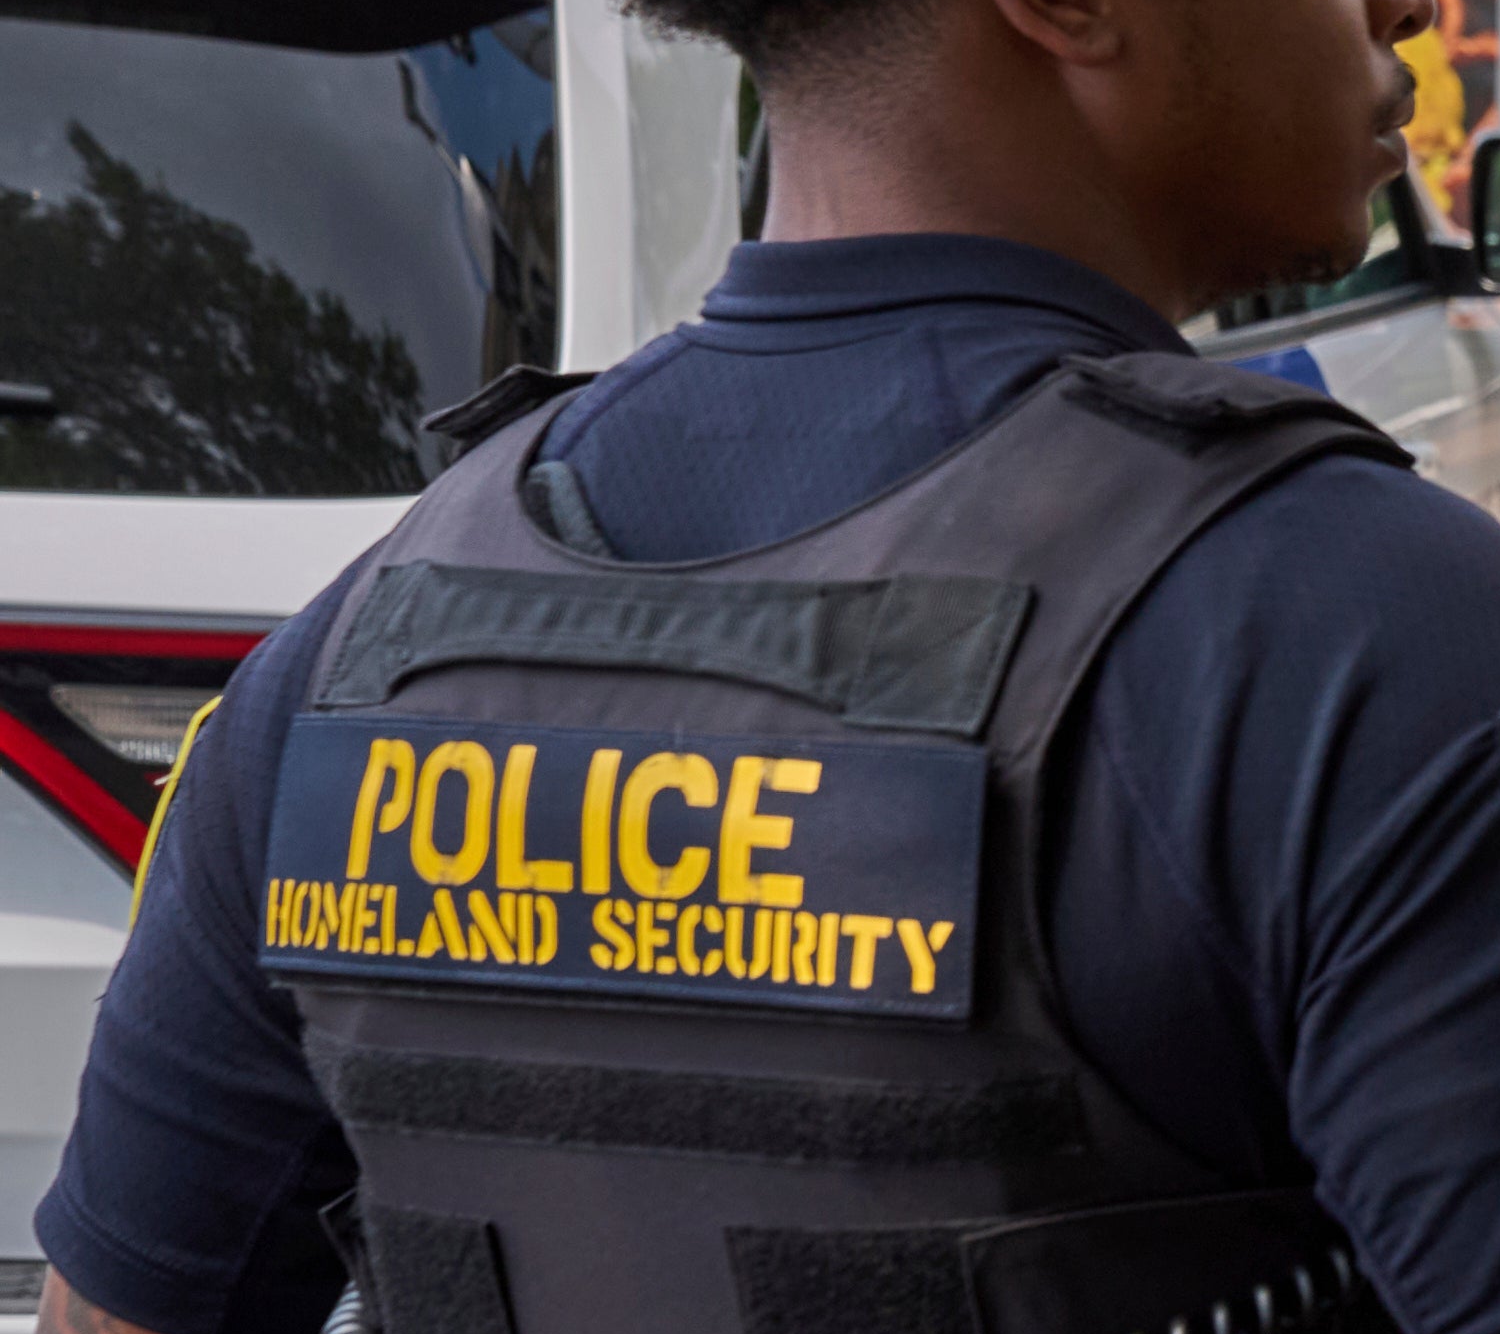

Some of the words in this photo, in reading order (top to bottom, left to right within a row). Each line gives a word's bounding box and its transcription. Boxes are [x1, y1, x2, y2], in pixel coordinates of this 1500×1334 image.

[345, 737, 823, 908] POLICE
[265, 878, 560, 966] HOMELAND
[589, 898, 955, 995] SECURITY
